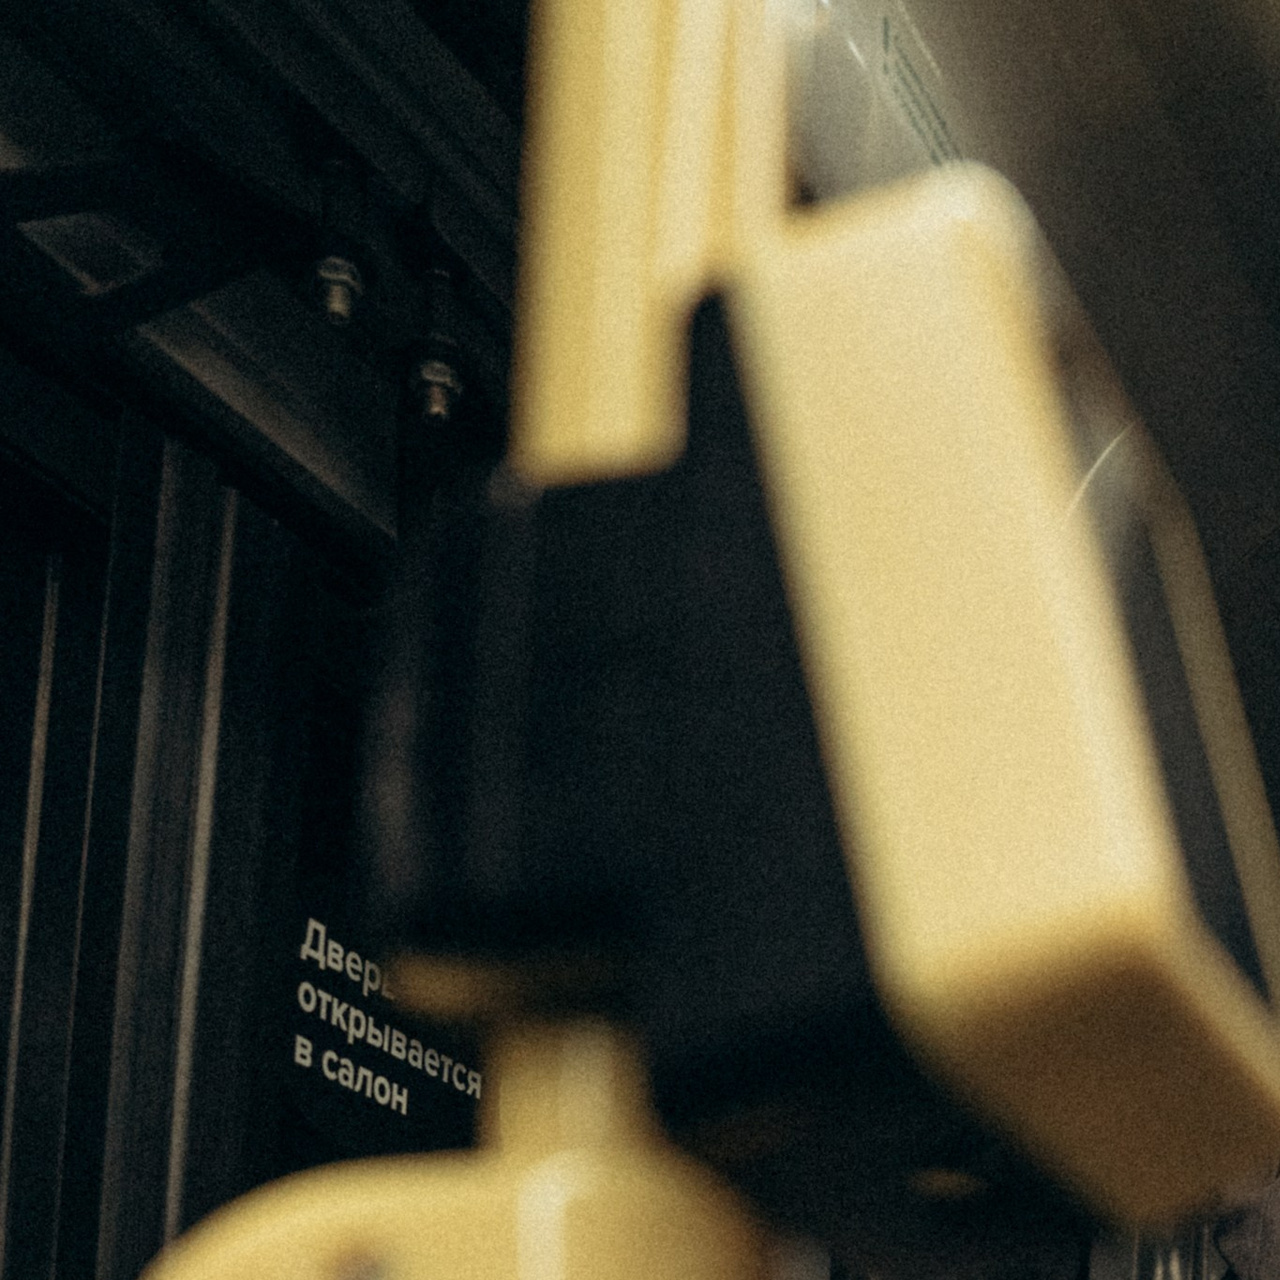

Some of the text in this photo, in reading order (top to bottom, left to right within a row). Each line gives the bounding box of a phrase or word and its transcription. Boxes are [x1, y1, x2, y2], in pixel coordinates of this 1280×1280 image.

[293, 1034, 409, 1116] в салон
[297, 981, 482, 1100] открывается
